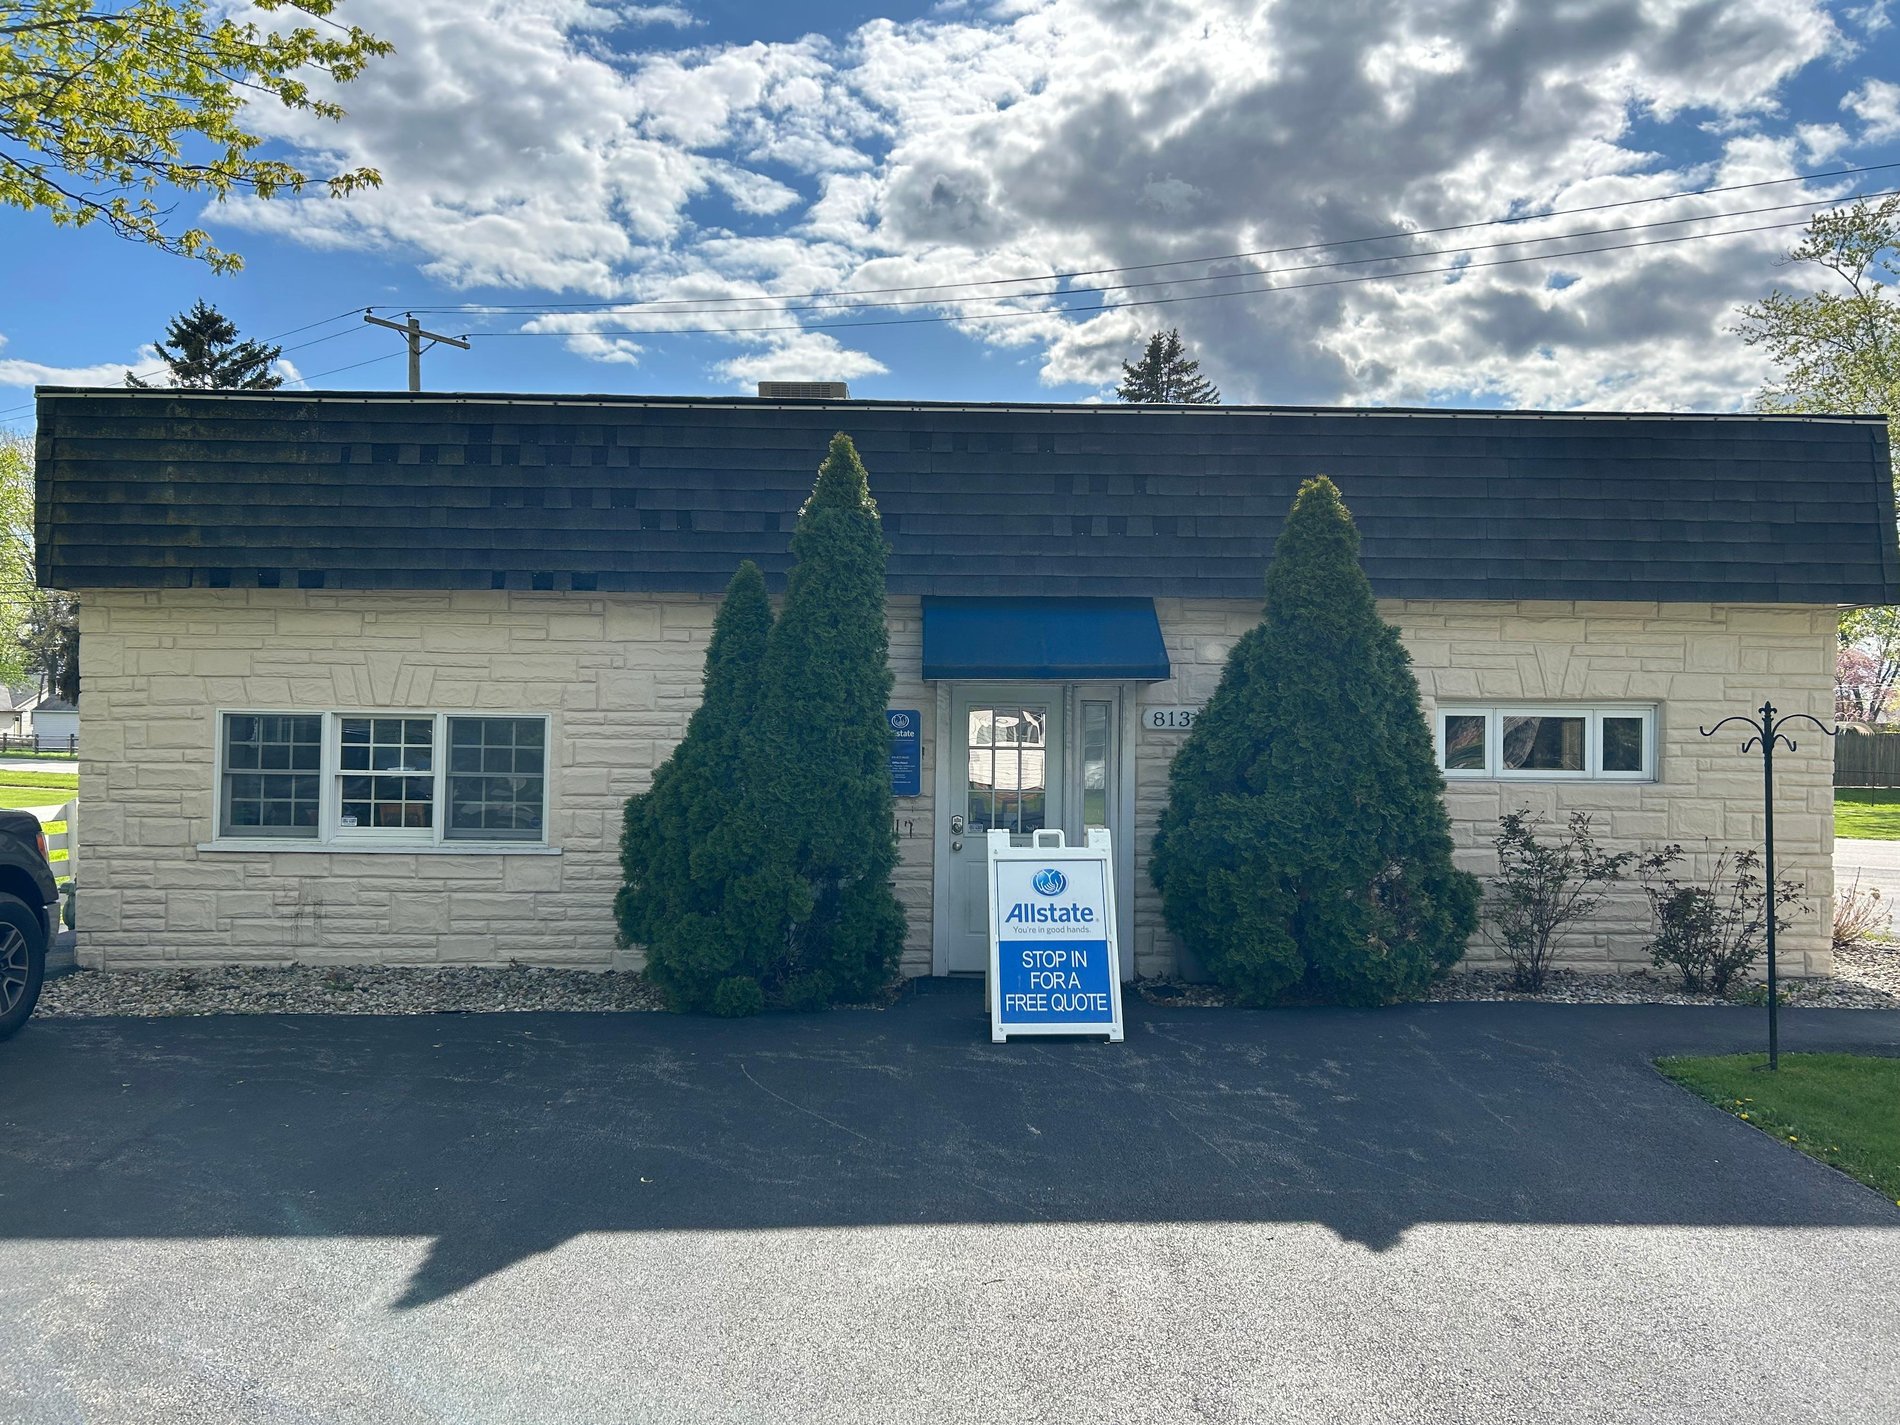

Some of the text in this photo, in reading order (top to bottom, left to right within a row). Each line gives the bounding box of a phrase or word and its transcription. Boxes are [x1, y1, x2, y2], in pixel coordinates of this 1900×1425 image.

[1153, 711, 1190, 727] 813
[1005, 903, 1094, 923] Allstate
[1013, 926, 1037, 934] You're
[1046, 926, 1065, 935] good
[1066, 926, 1092, 934] hands.
[1022, 950, 1088, 968] STOP IN
[1030, 971, 1081, 990] FOR A
[1005, 993, 1108, 1012] FREE QUOTE
